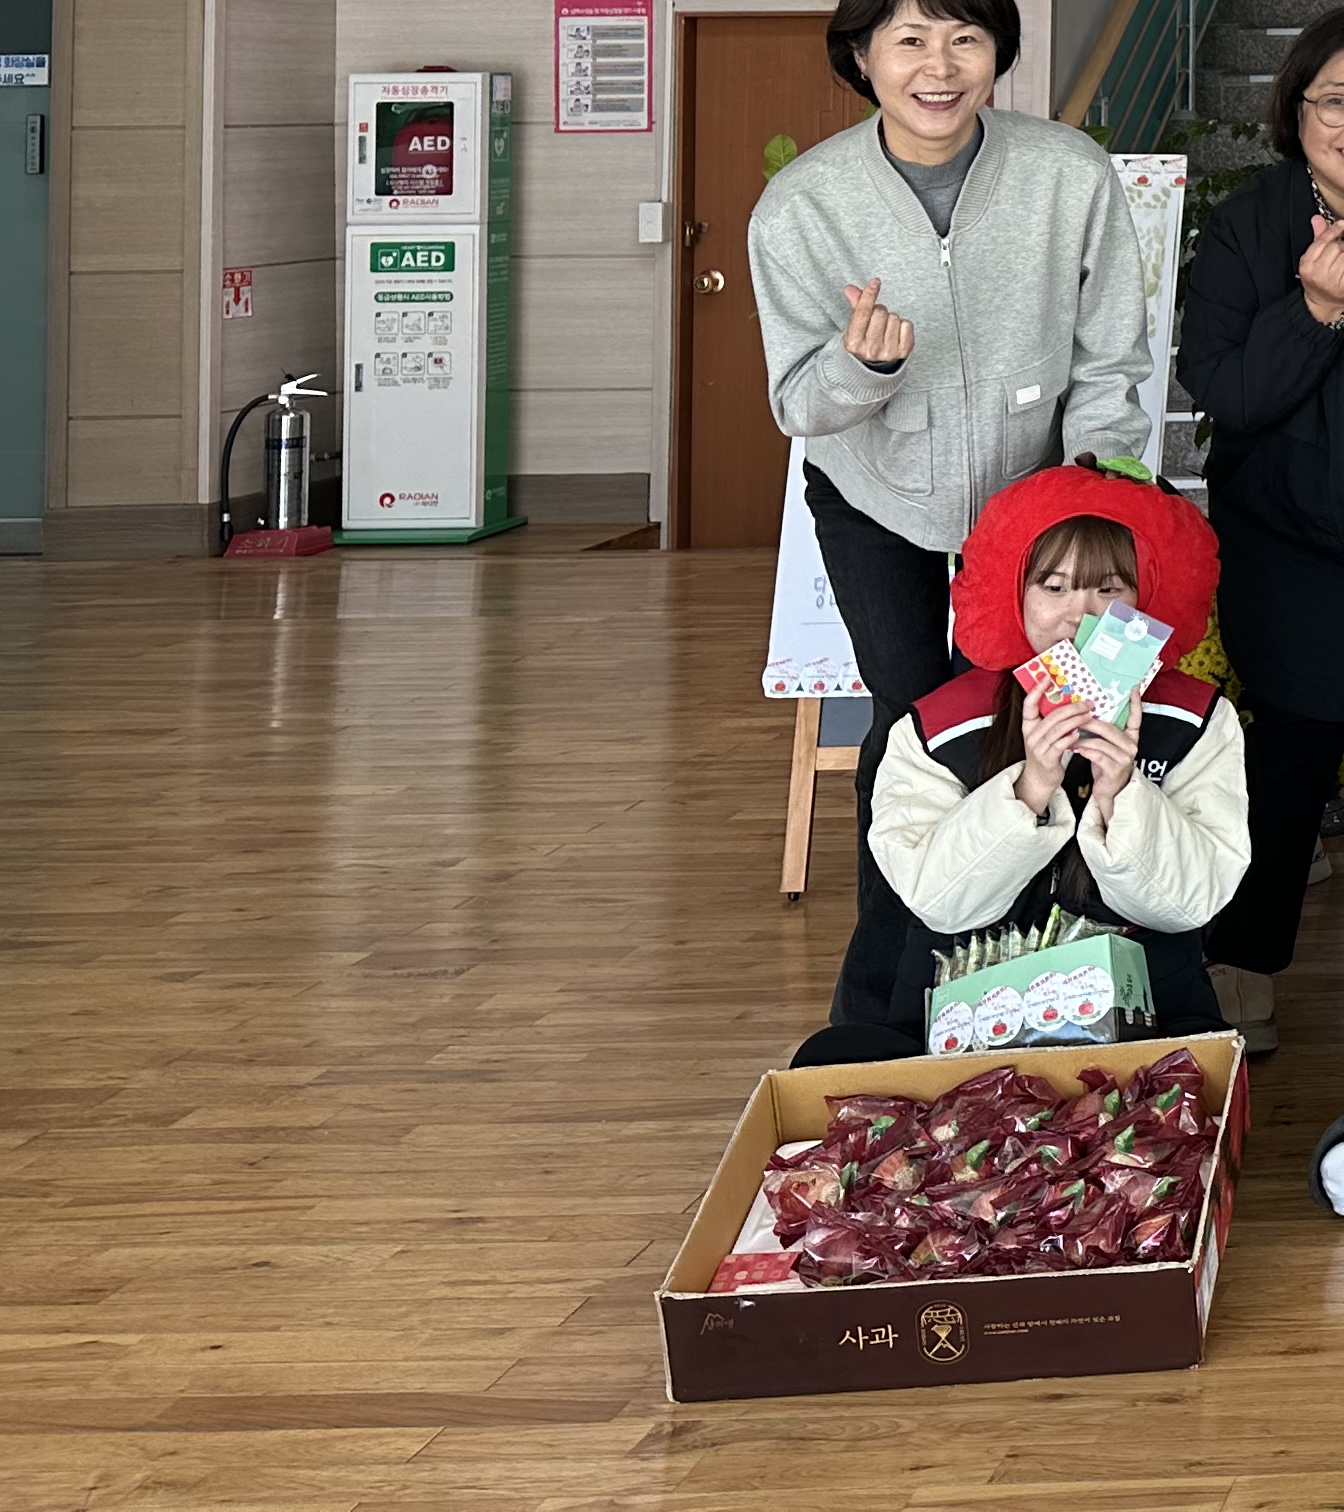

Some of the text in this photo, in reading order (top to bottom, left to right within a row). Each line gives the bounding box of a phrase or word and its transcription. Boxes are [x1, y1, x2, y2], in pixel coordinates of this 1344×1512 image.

[408, 136, 451, 152] AED
[401, 251, 446, 267] AED
[399, 493, 439, 501] RADIAN
[838, 1324, 899, 1351] 사과
